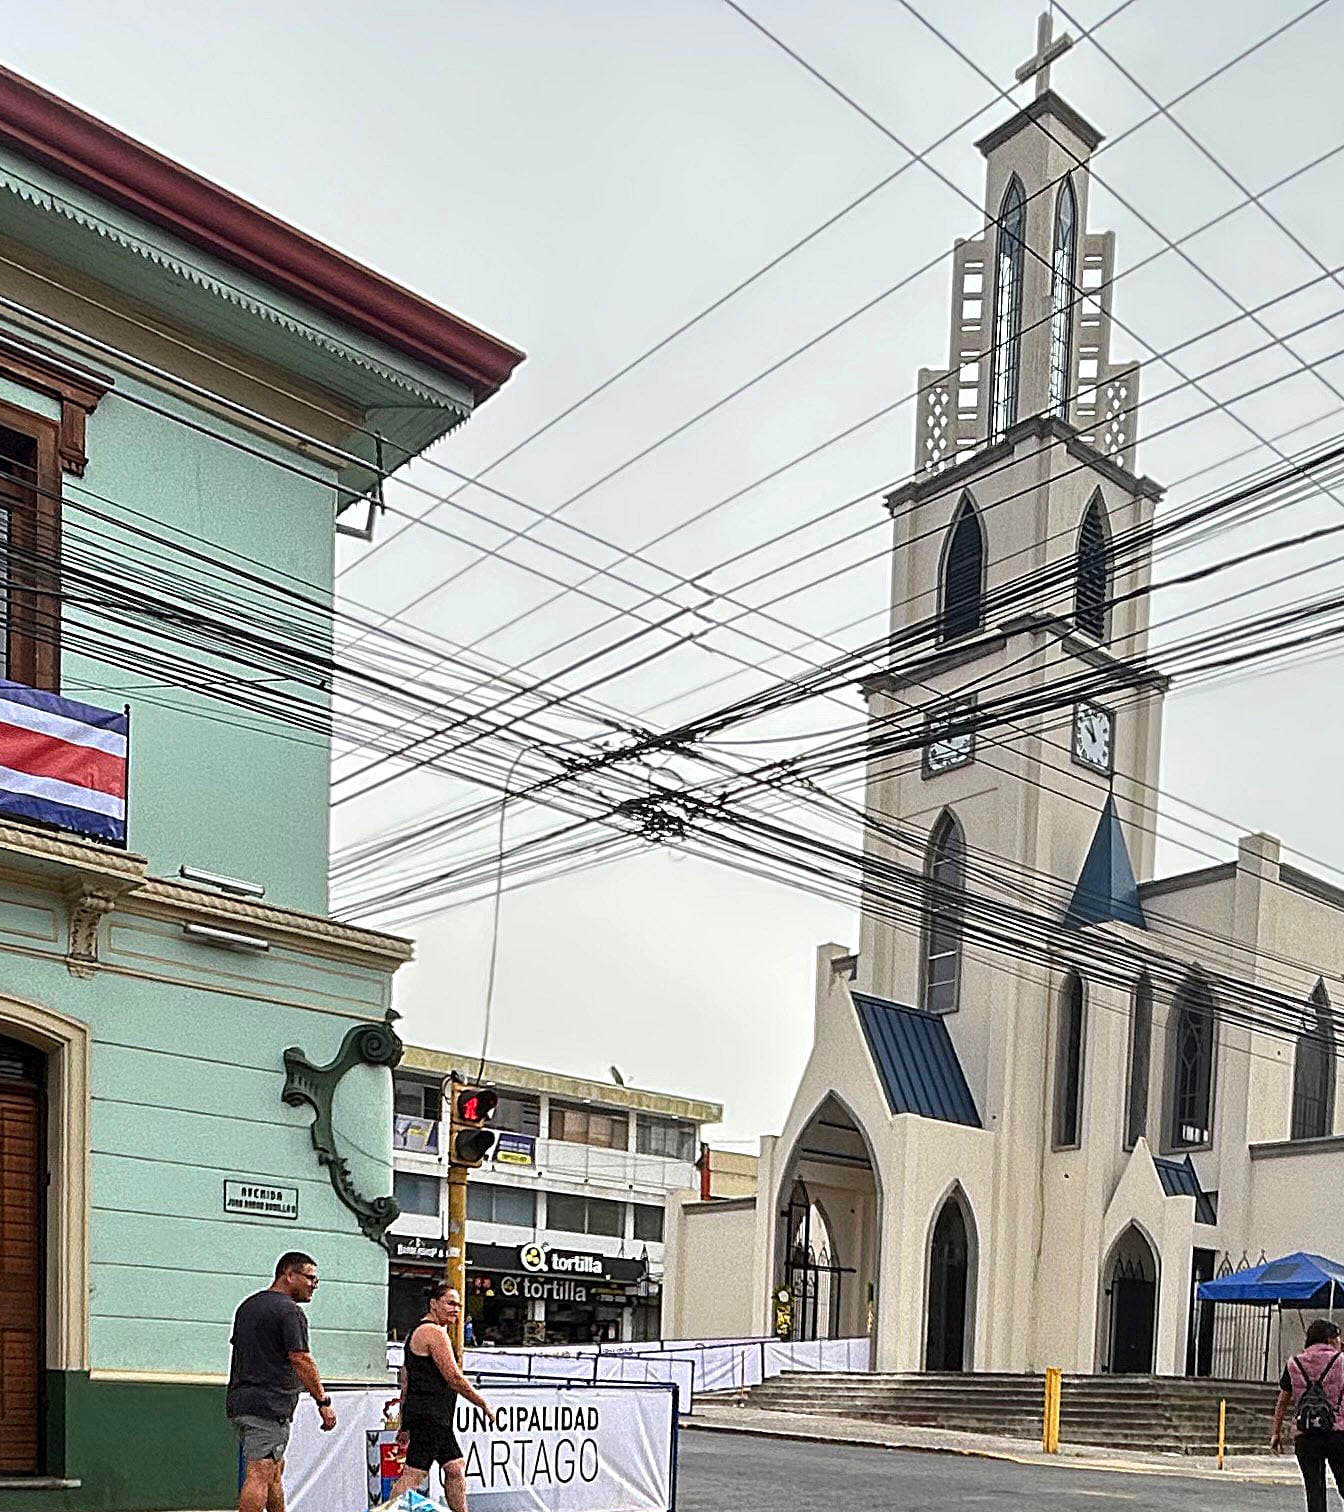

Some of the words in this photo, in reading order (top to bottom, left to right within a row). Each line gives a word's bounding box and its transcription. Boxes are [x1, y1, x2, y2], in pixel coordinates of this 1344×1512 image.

[241, 1187, 283, 1201] AVENIDA
[551, 1253, 603, 1274] tortilla
[523, 1277, 587, 1301] tortilla
[456, 1406, 599, 1432] UNCIPALIDAD
